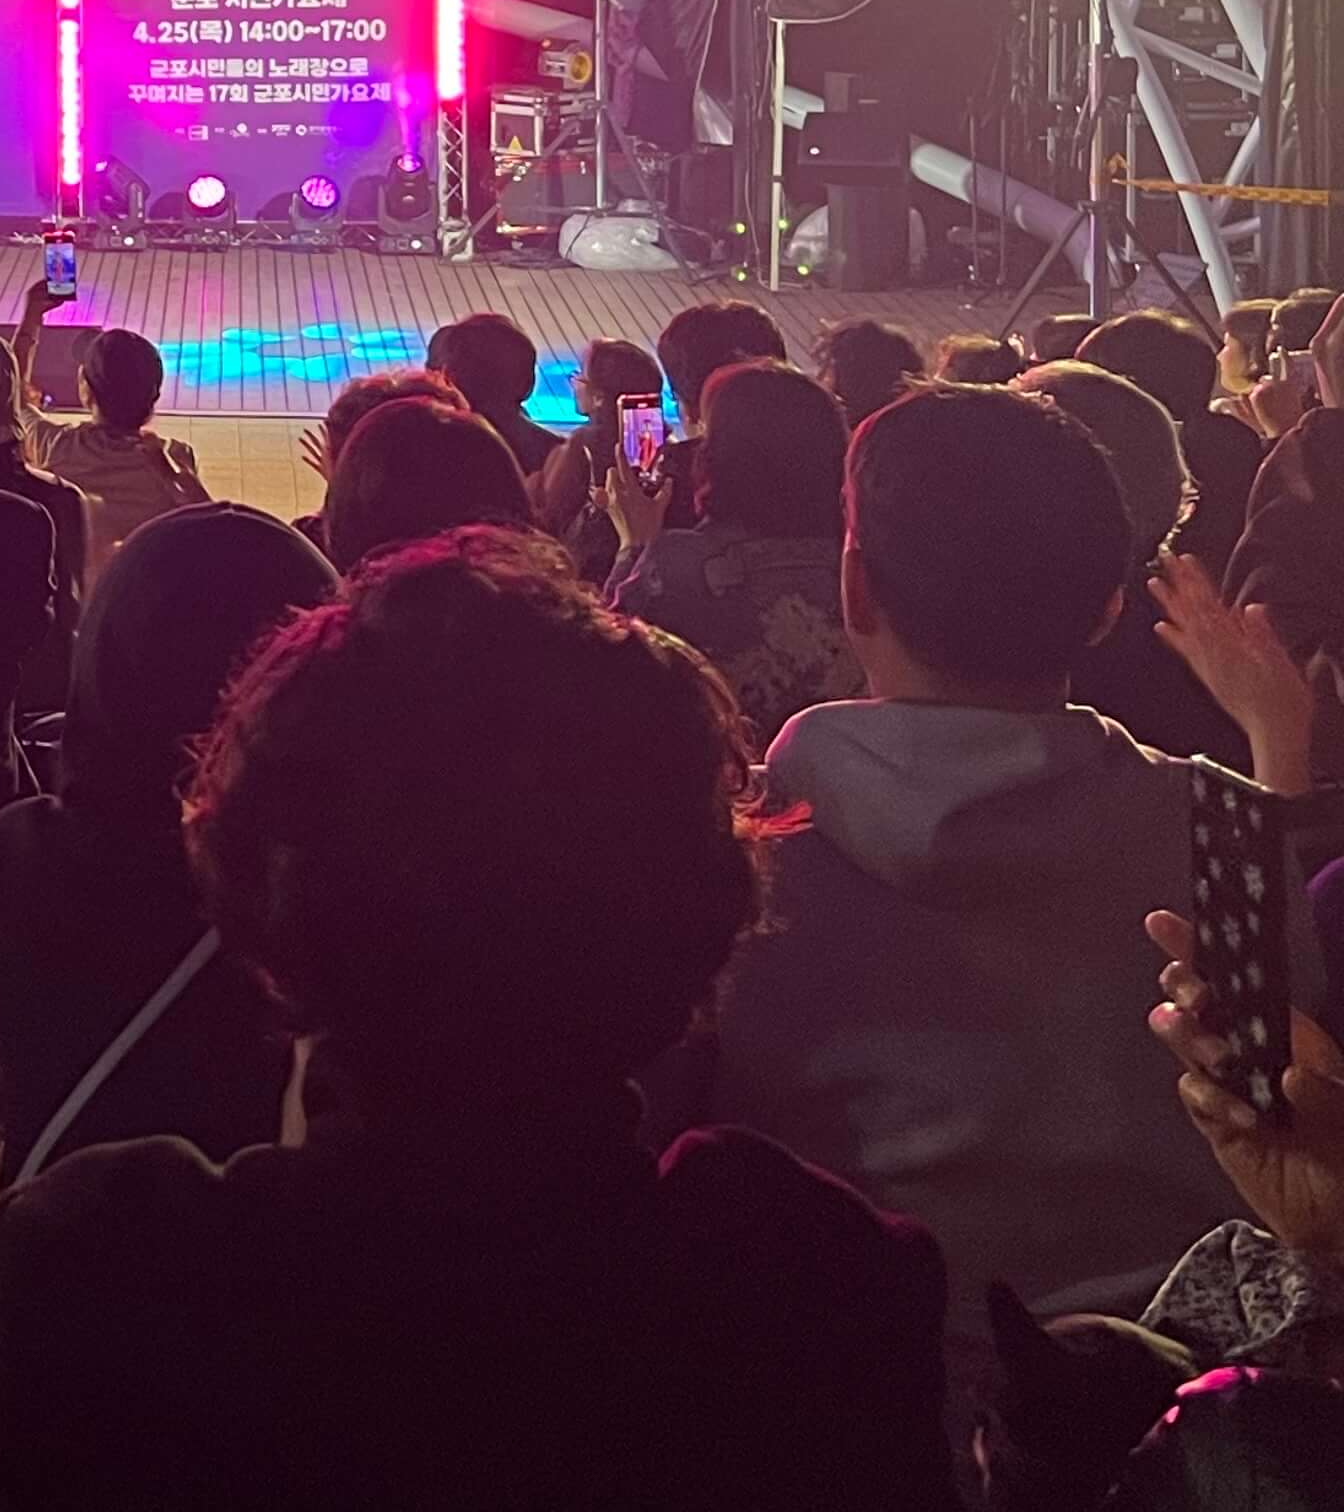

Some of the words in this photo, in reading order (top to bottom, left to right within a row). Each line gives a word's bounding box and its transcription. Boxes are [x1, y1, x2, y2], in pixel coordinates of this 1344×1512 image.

[132, 20, 234, 44] 4.25(목)
[239, 19, 387, 43] 14:00~17:00
[149, 58, 263, 79] 군포시민들의
[128, 84, 204, 104] 꾸며지는
[209, 84, 249, 103] 17회
[253, 82, 392, 103] 군포시민가요제
